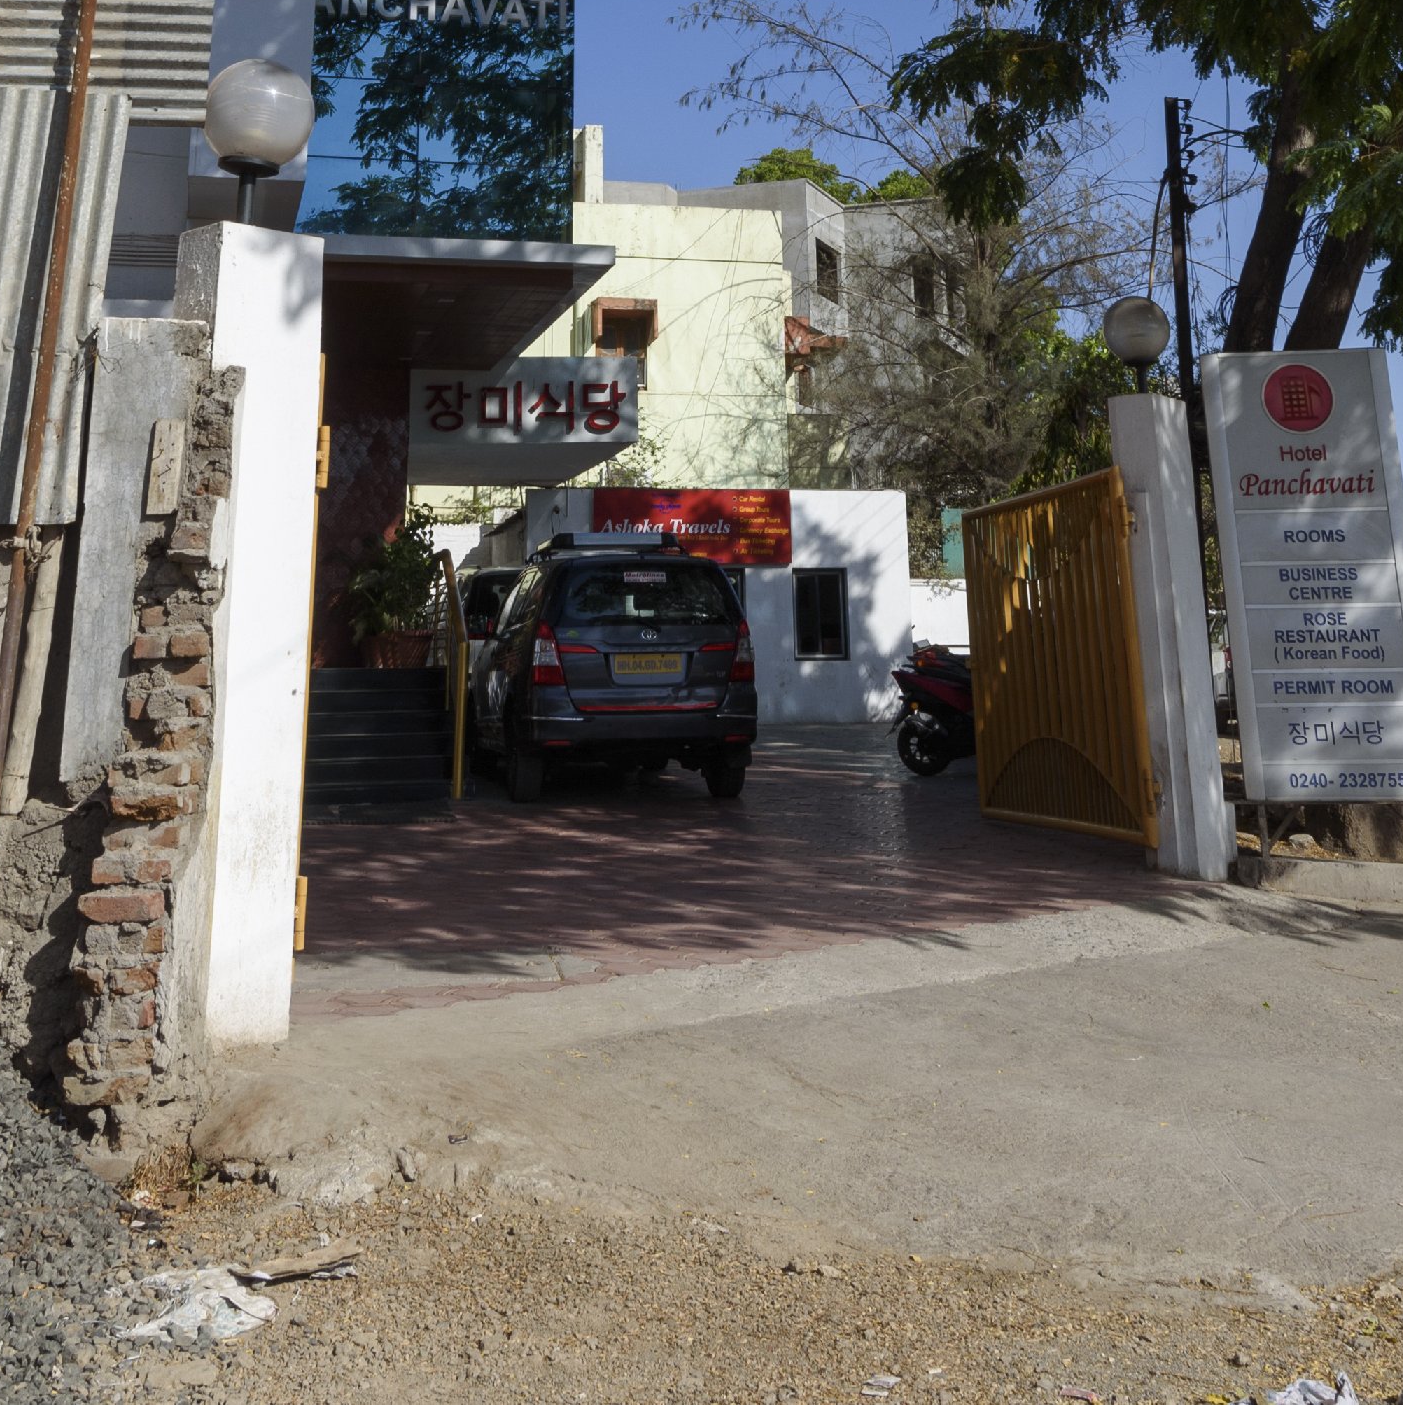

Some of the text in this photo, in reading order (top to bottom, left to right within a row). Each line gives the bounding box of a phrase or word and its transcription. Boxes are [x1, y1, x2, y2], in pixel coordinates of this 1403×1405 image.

[425, 380, 627, 435] 장미식당
[1279, 444, 1327, 462] Hotel
[1239, 468, 1376, 497] Panchavati
[601, 518, 731, 534] Ashoka Travels
[1283, 529, 1346, 543] ROOMS
[1279, 567, 1358, 582] BUSINESS
[1288, 586, 1353, 600] CENTRE
[1302, 612, 1347, 626] ROSE
[1275, 629, 1380, 644] RESTAURANT
[1341, 645, 1385, 662] Food)
[1273, 680, 1394, 695] PERMIT ROOM
[1288, 720, 1385, 746] 장미식당
[1289, 773, 1334, 788] 0240-
